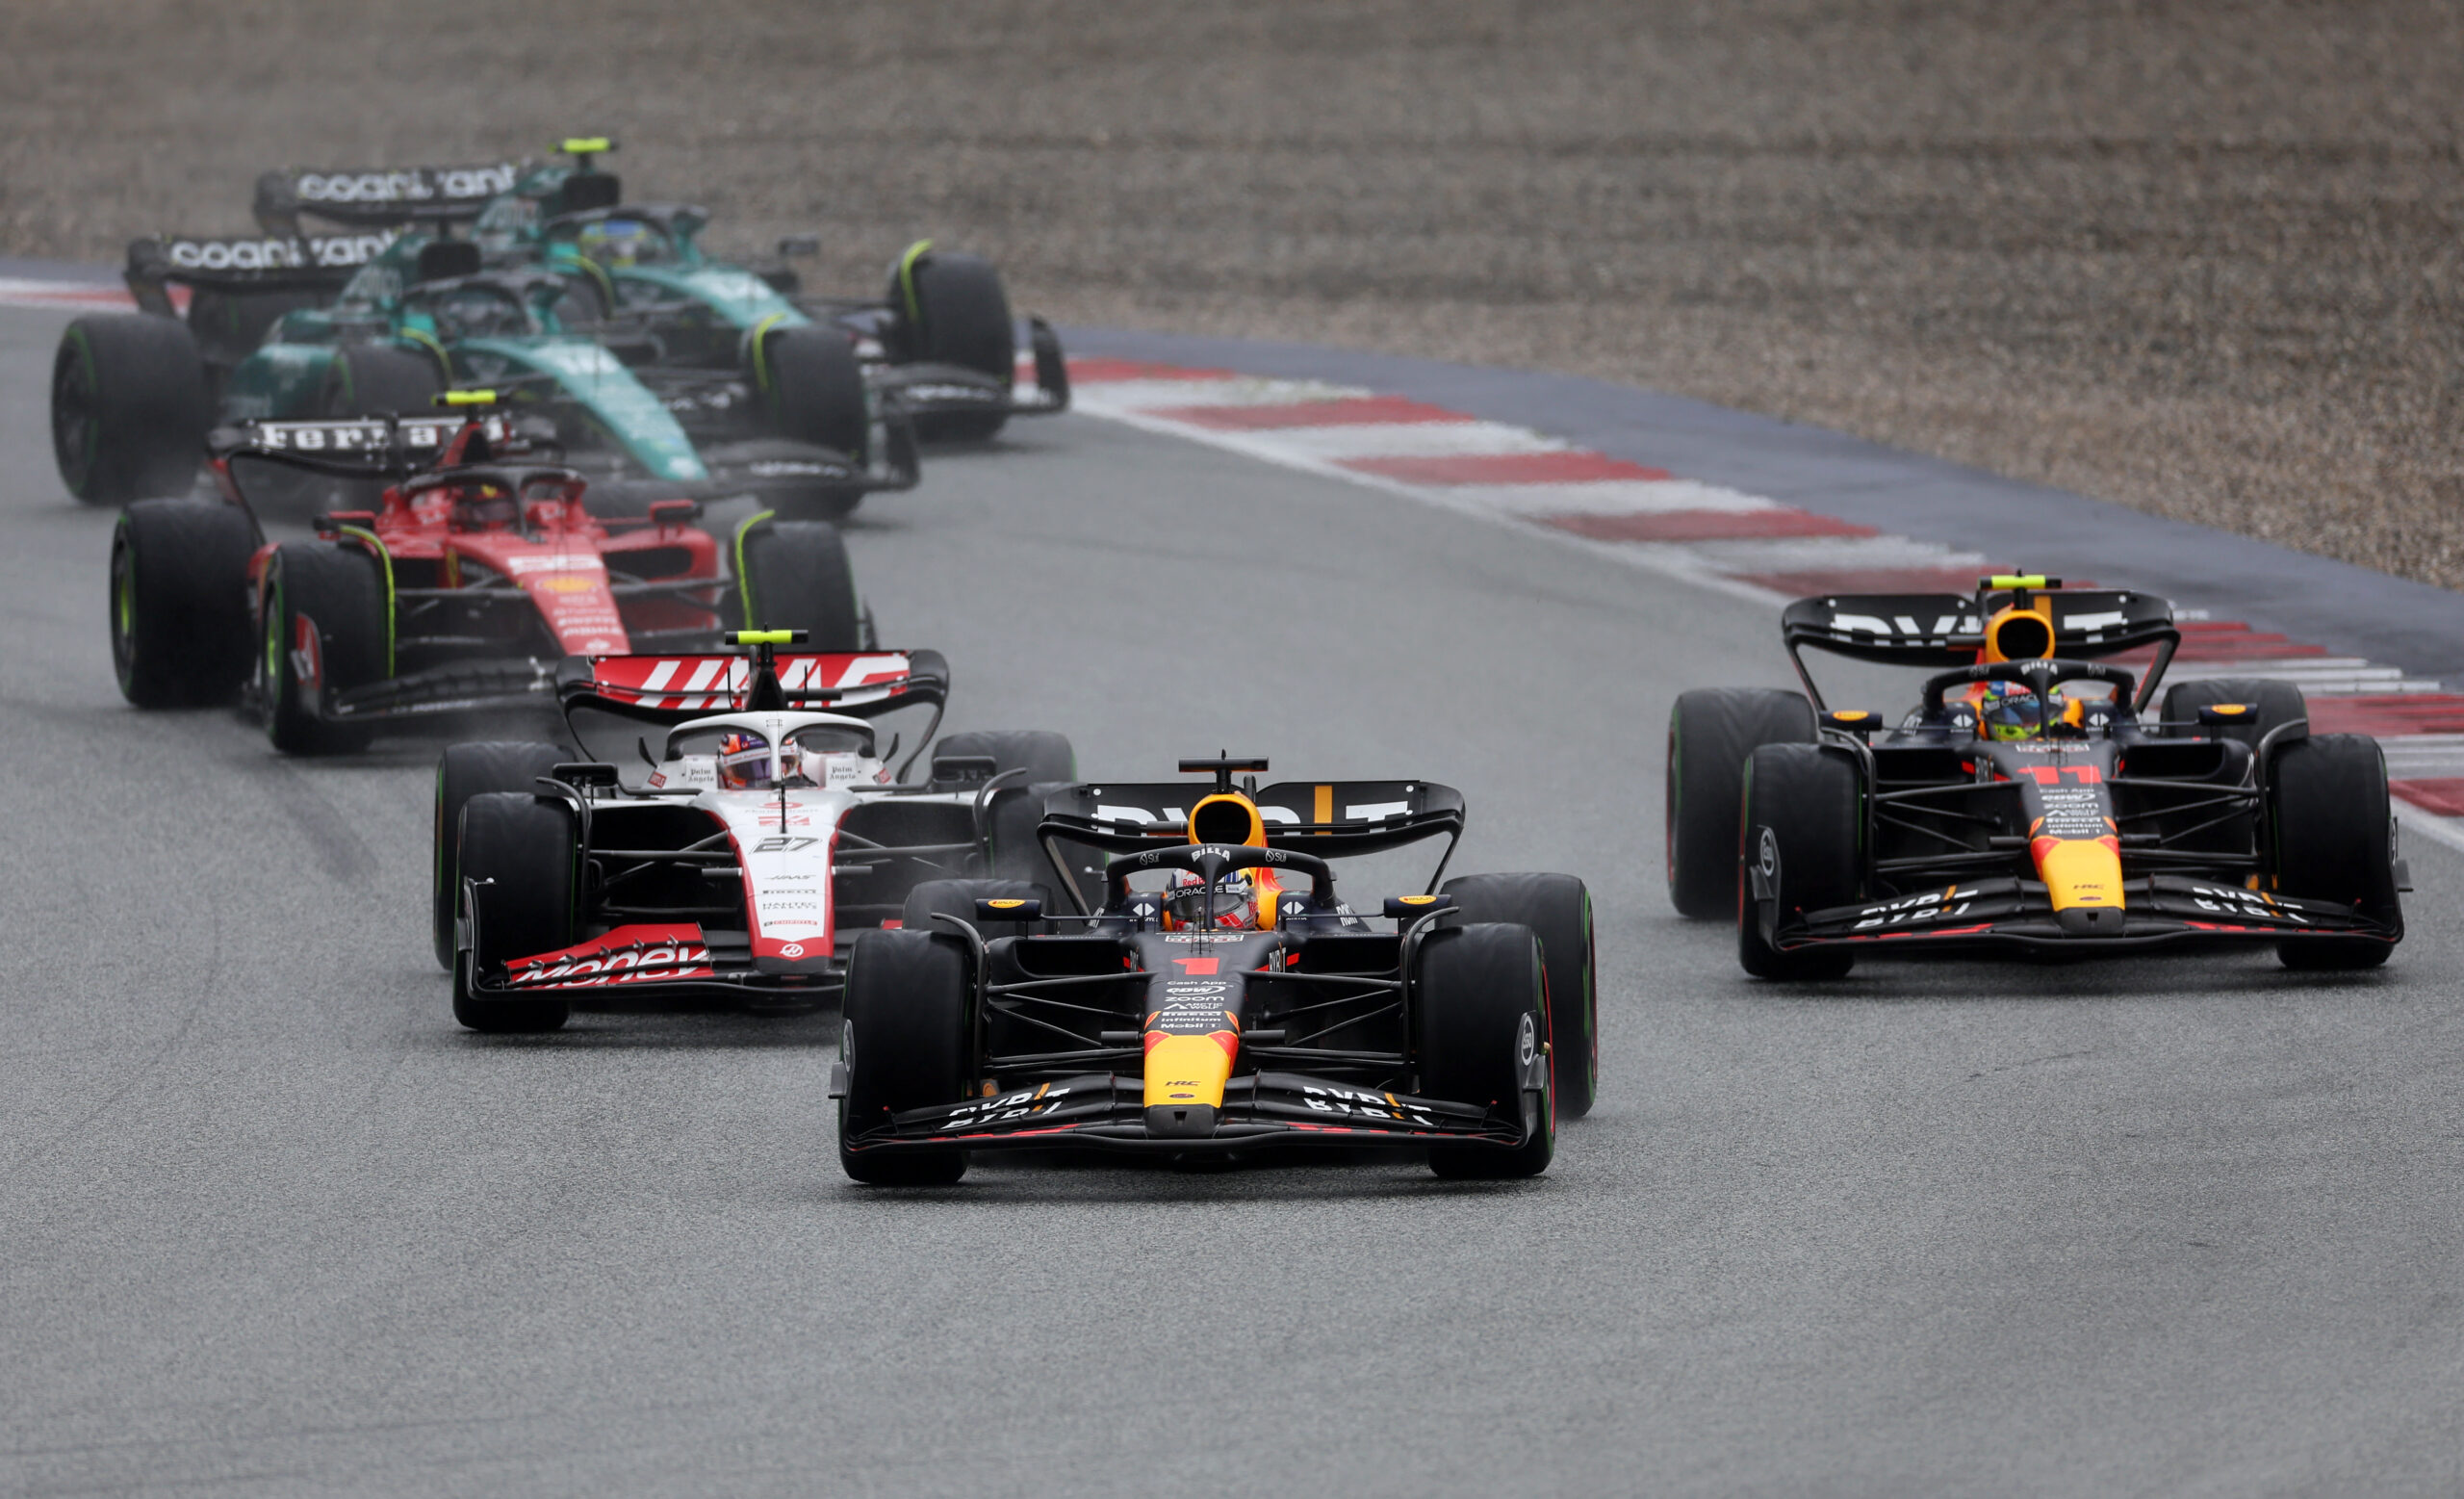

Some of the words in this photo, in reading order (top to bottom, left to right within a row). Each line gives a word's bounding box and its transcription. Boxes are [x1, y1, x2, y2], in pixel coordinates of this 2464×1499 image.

[690, 767, 711, 776] Palm
[832, 765, 853, 775] Palm
[2016, 765, 2102, 785] 11
[750, 837, 820, 854] 27
[1191, 847, 1231, 863] BILLA
[1274, 852, 1287, 863] Sui
[1175, 886, 1224, 898] ORACE
[515, 946, 707, 989] Money
[1171, 957, 1219, 975] 1
